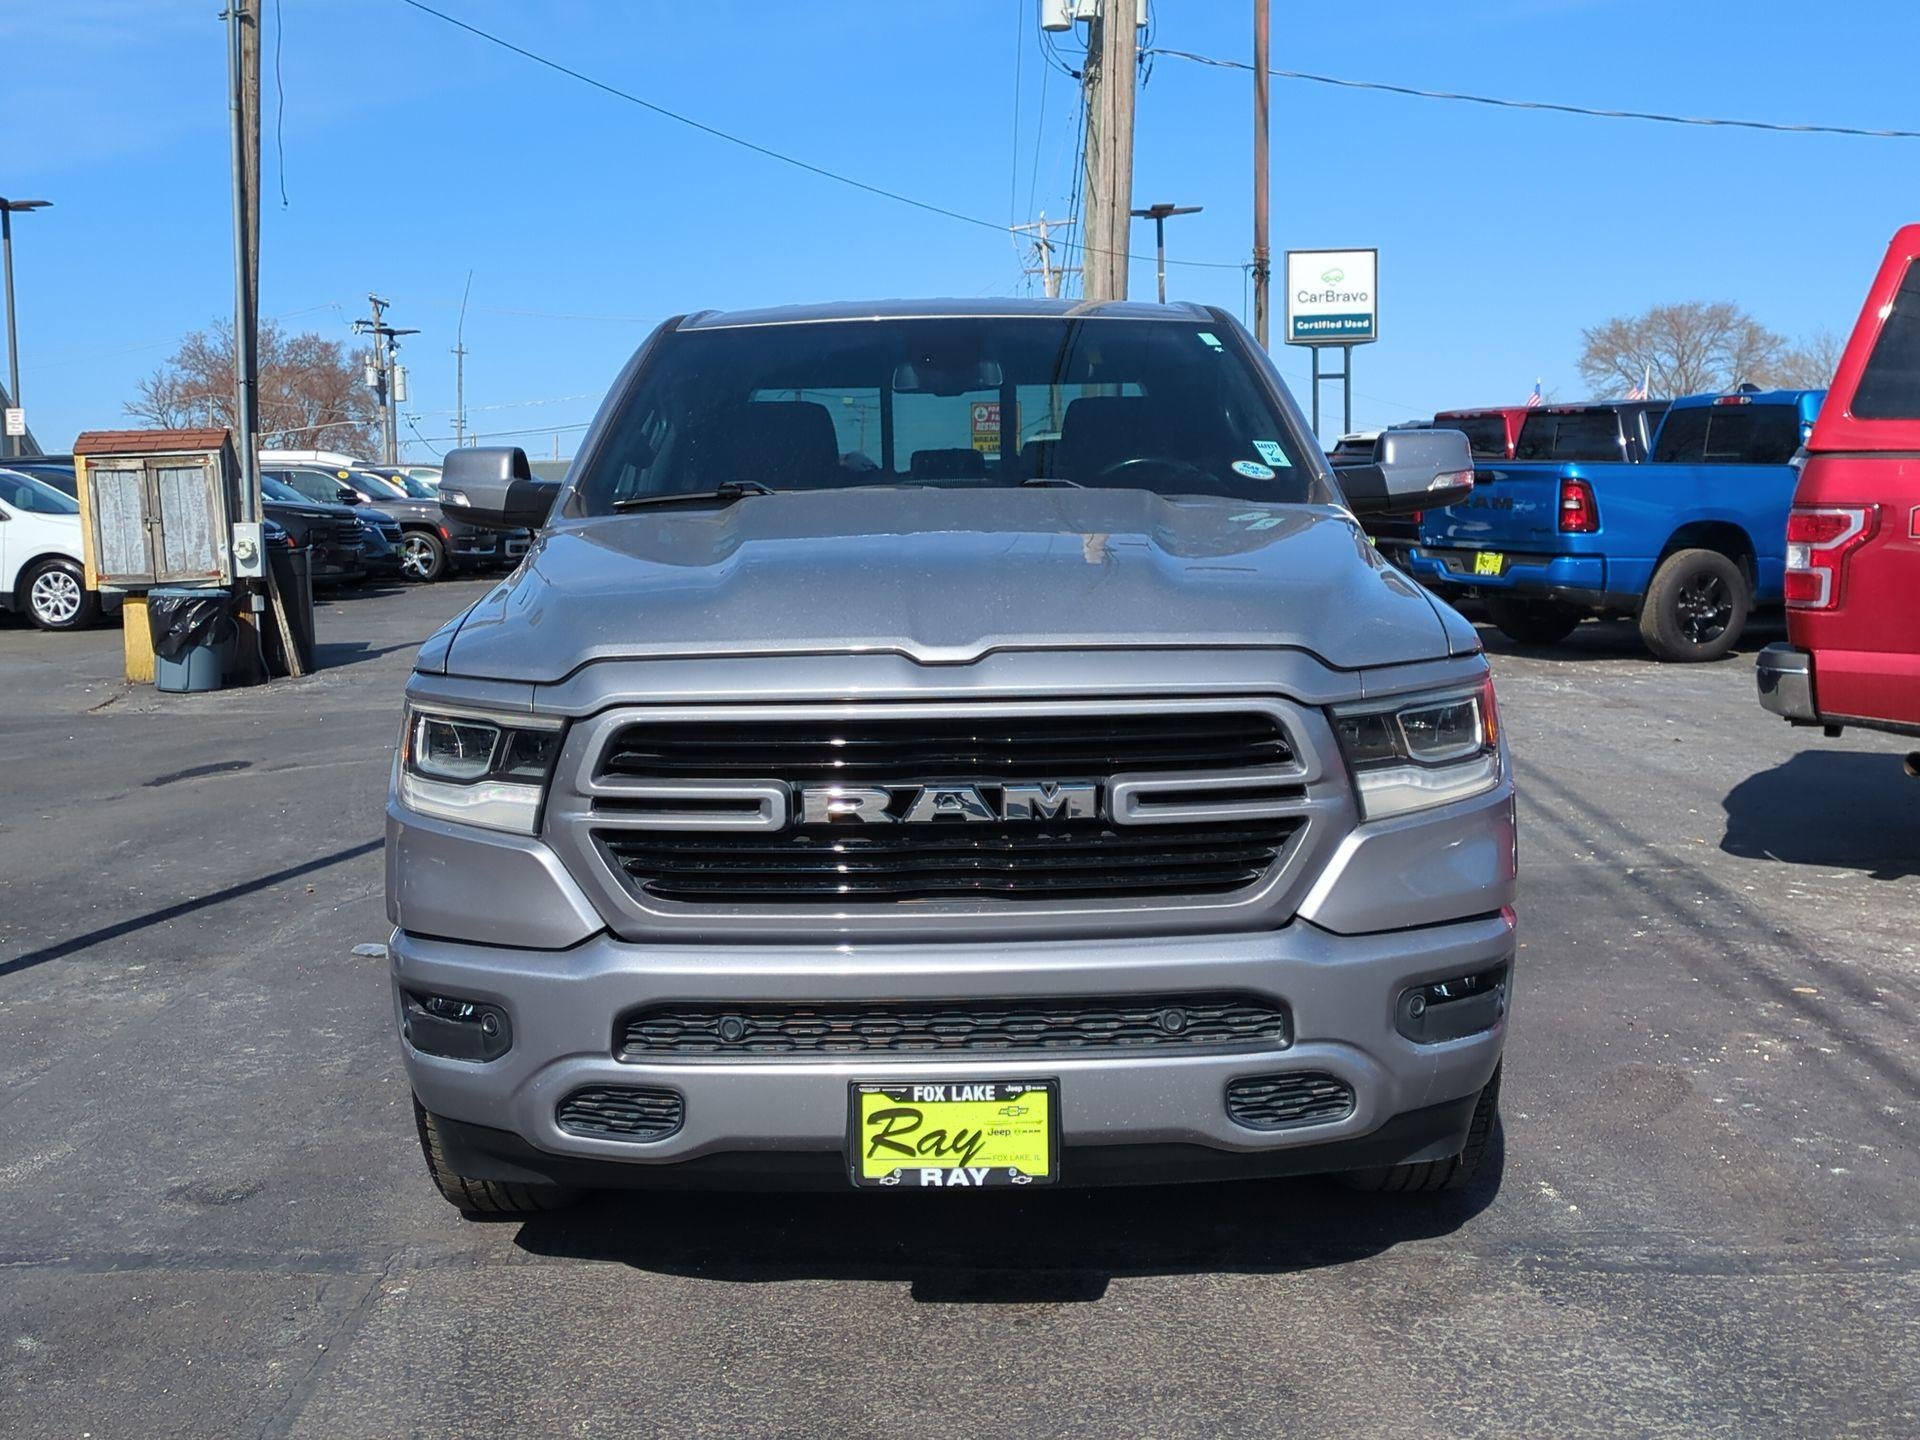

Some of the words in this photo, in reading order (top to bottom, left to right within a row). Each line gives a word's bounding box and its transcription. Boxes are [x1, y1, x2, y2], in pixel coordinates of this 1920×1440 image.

[1297, 290, 1368, 303] CarBravo
[1297, 320, 1342, 329] Certified
[1344, 319, 1369, 328] Used
[802, 782, 1097, 823] RAM
[913, 1086, 946, 1102] FOX
[951, 1085, 996, 1101] LAKE
[1005, 1084, 1023, 1093] Jeep
[866, 1107, 986, 1167] Ray
[987, 1128, 1011, 1138] Jeep
[920, 1168, 990, 1186] RAY
